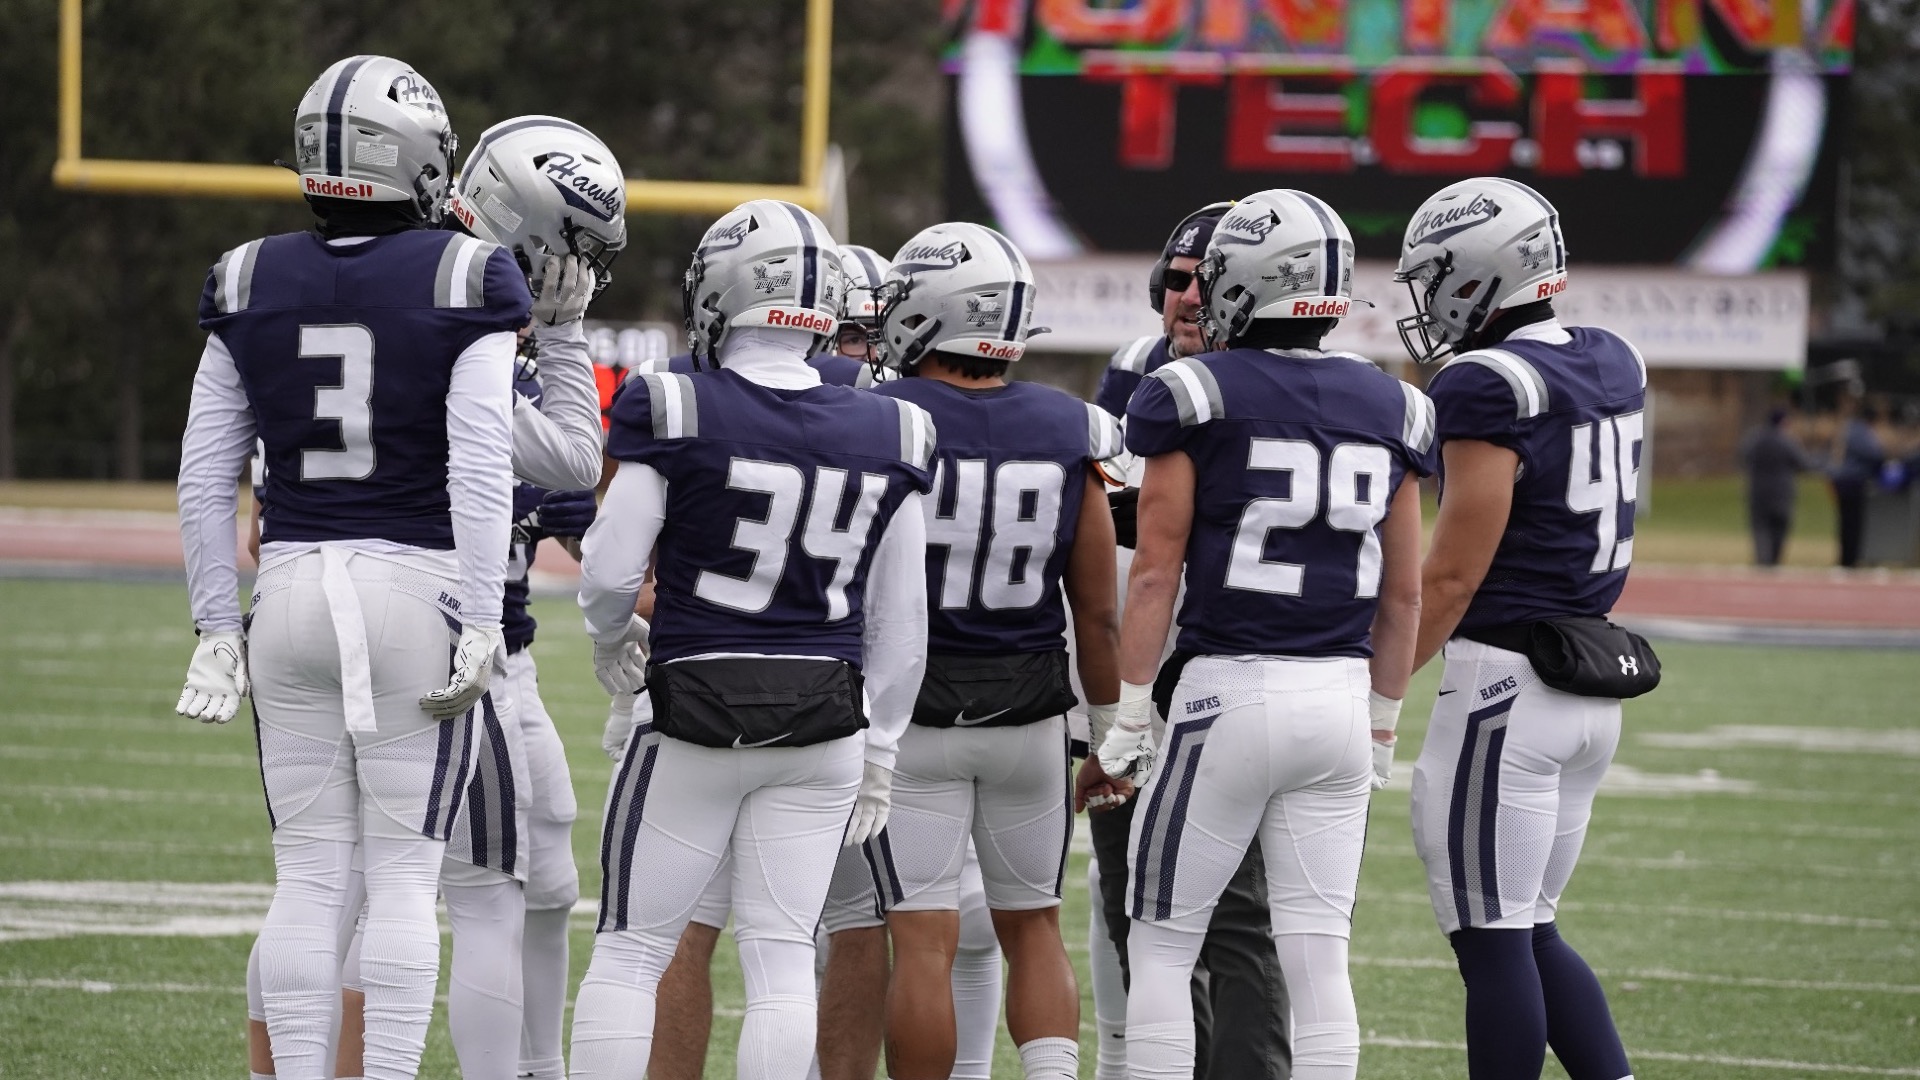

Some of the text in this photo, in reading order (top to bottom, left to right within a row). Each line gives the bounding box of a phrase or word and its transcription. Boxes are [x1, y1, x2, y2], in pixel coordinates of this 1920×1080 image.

[1081, 51, 1686, 176] TECH
[305, 178, 373, 197] Riddell
[473, 186, 481, 199] 2
[547, 152, 621, 218] Hawks
[1412, 193, 1494, 239] Hawks
[767, 309, 832, 333] Riddell
[1292, 300, 1350, 317] Riddell
[299, 323, 376, 481] 3
[926, 459, 1067, 611] 48
[1223, 437, 1392, 599] 29
[693, 456, 889, 623] 34
[437, 591, 462, 612] HAW
[1185, 696, 1220, 714] HAWKS
[1480, 675, 1517, 700] HAWKS
